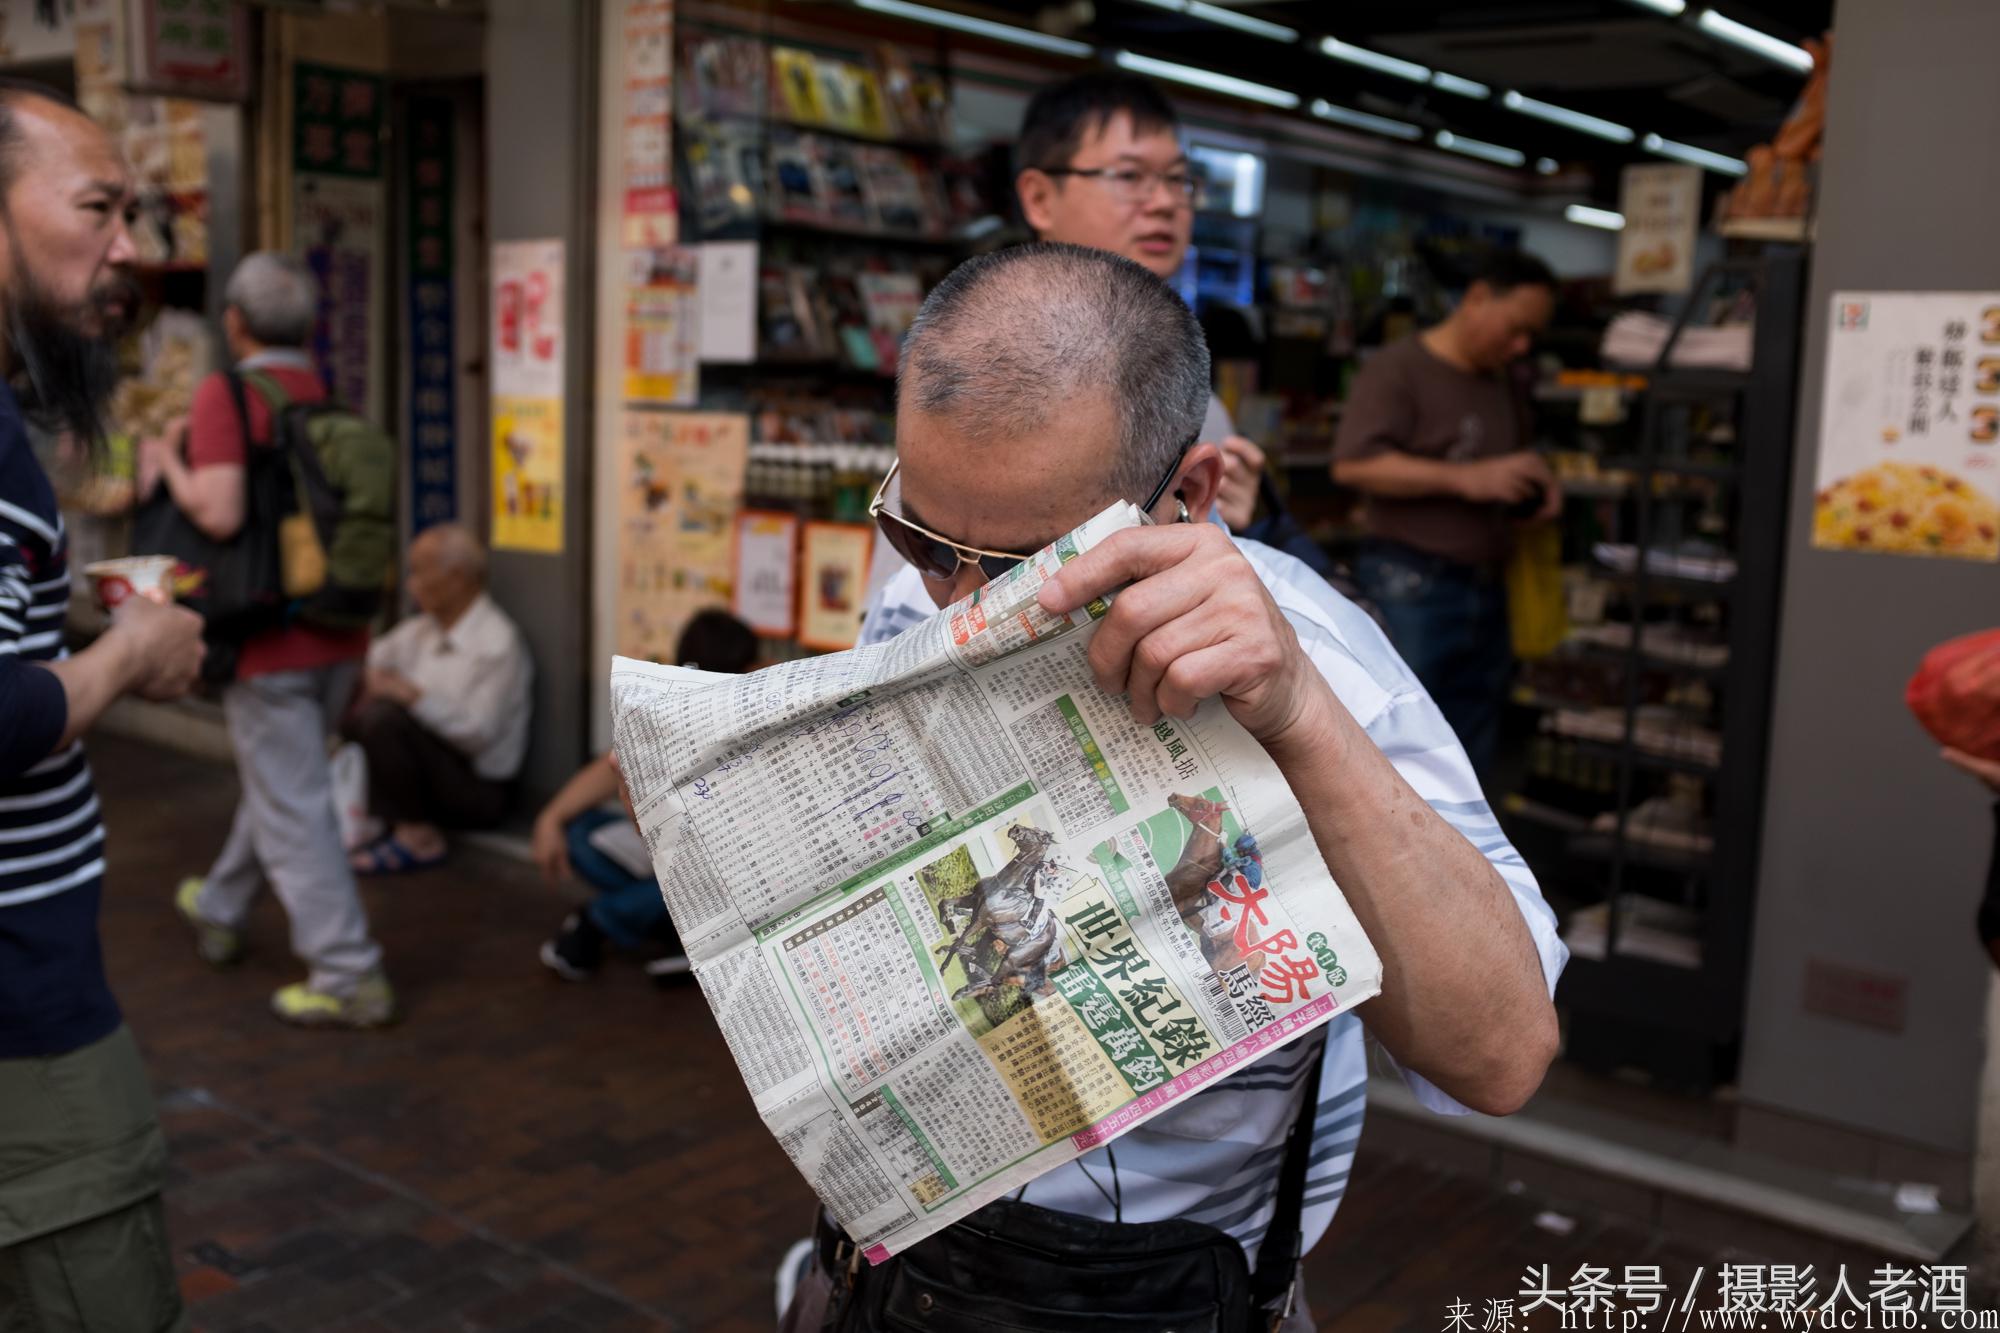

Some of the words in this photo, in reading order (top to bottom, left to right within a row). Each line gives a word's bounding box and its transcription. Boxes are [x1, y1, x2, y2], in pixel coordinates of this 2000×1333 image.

[1064, 900, 1211, 1070] 世界紀錄
[1204, 870, 1321, 999] 太陽
[1215, 961, 1275, 1033] 馬經
[1052, 962, 1164, 1093] 雷霆萬鈞
